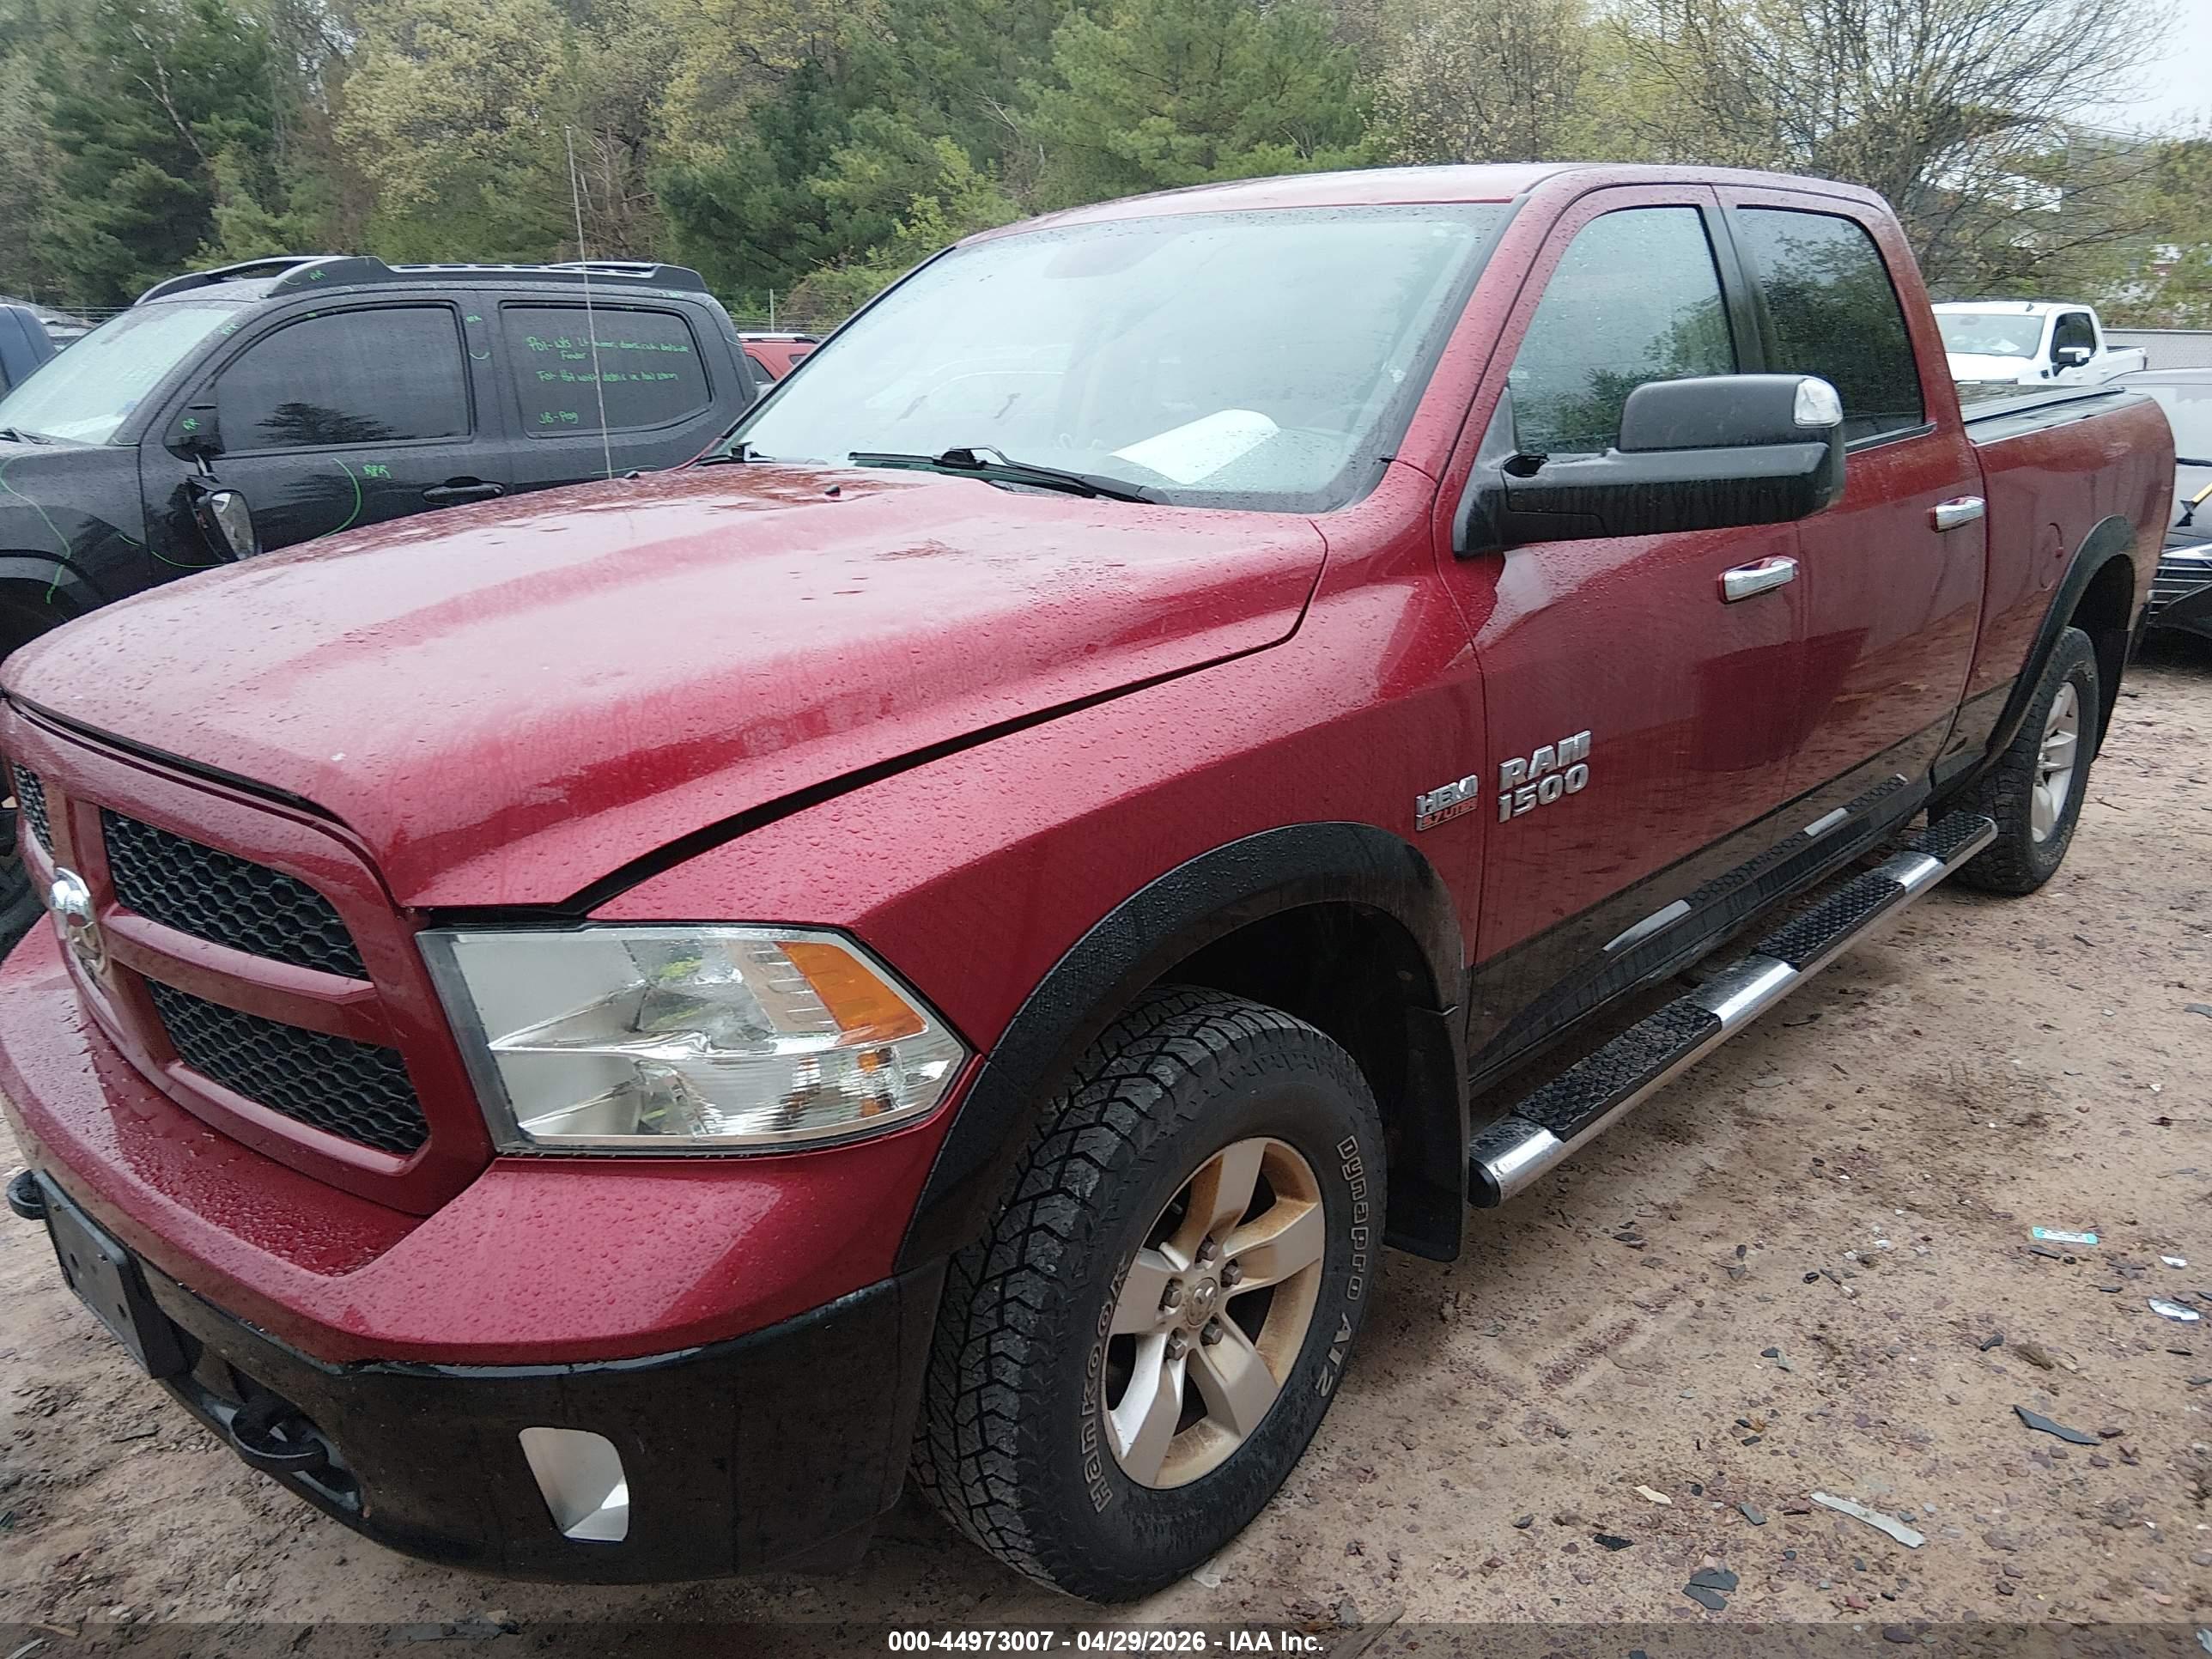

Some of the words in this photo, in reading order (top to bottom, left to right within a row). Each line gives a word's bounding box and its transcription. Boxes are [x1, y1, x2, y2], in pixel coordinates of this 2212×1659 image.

[1498, 730, 1591, 792] RAM
[1416, 775, 1479, 816] HEMI
[1498, 763, 1589, 823] 1500
[1336, 1134, 1370, 1302] Dynapro
